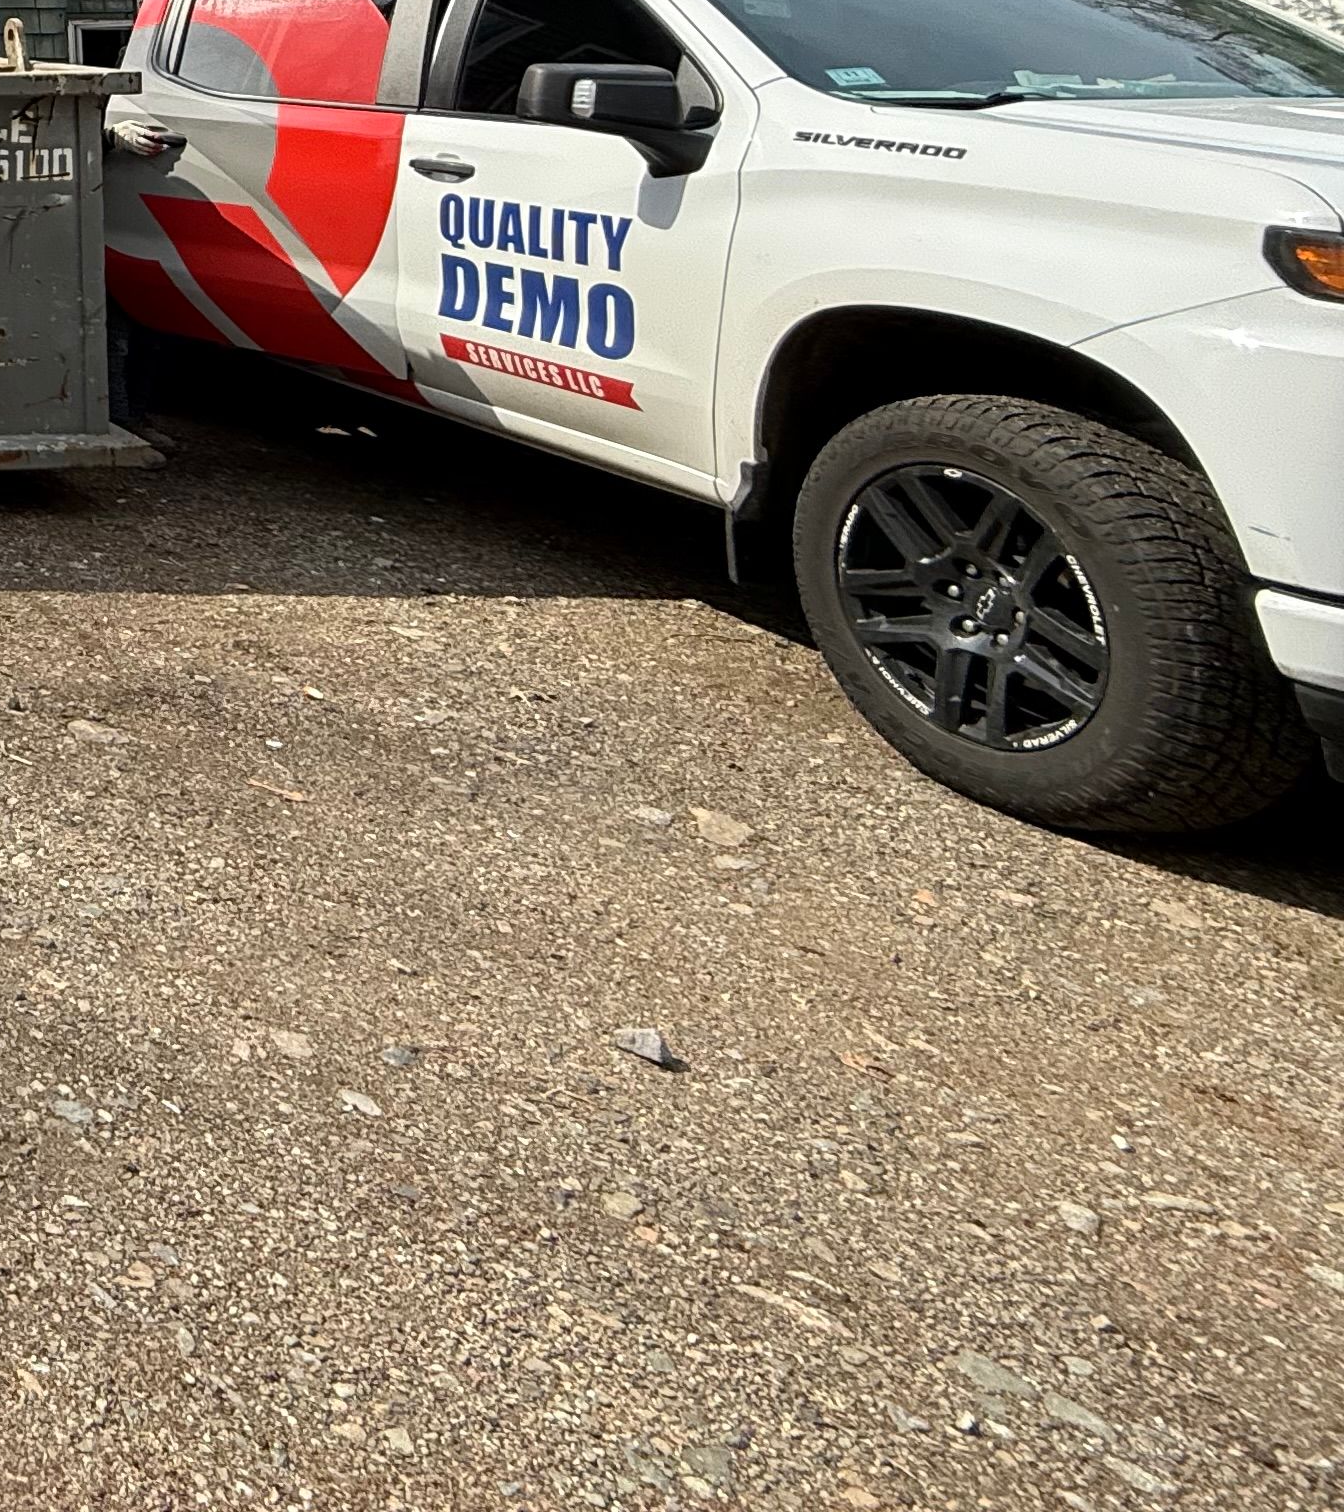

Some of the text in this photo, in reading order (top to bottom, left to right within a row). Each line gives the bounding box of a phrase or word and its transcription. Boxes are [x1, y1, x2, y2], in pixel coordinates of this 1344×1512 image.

[792, 130, 968, 159] SILVERADO
[439, 192, 634, 272] QUALITY
[438, 253, 635, 360] DEMO
[465, 342, 605, 397] SERVICES LLC
[1012, 719, 1079, 749] SILVERAD
